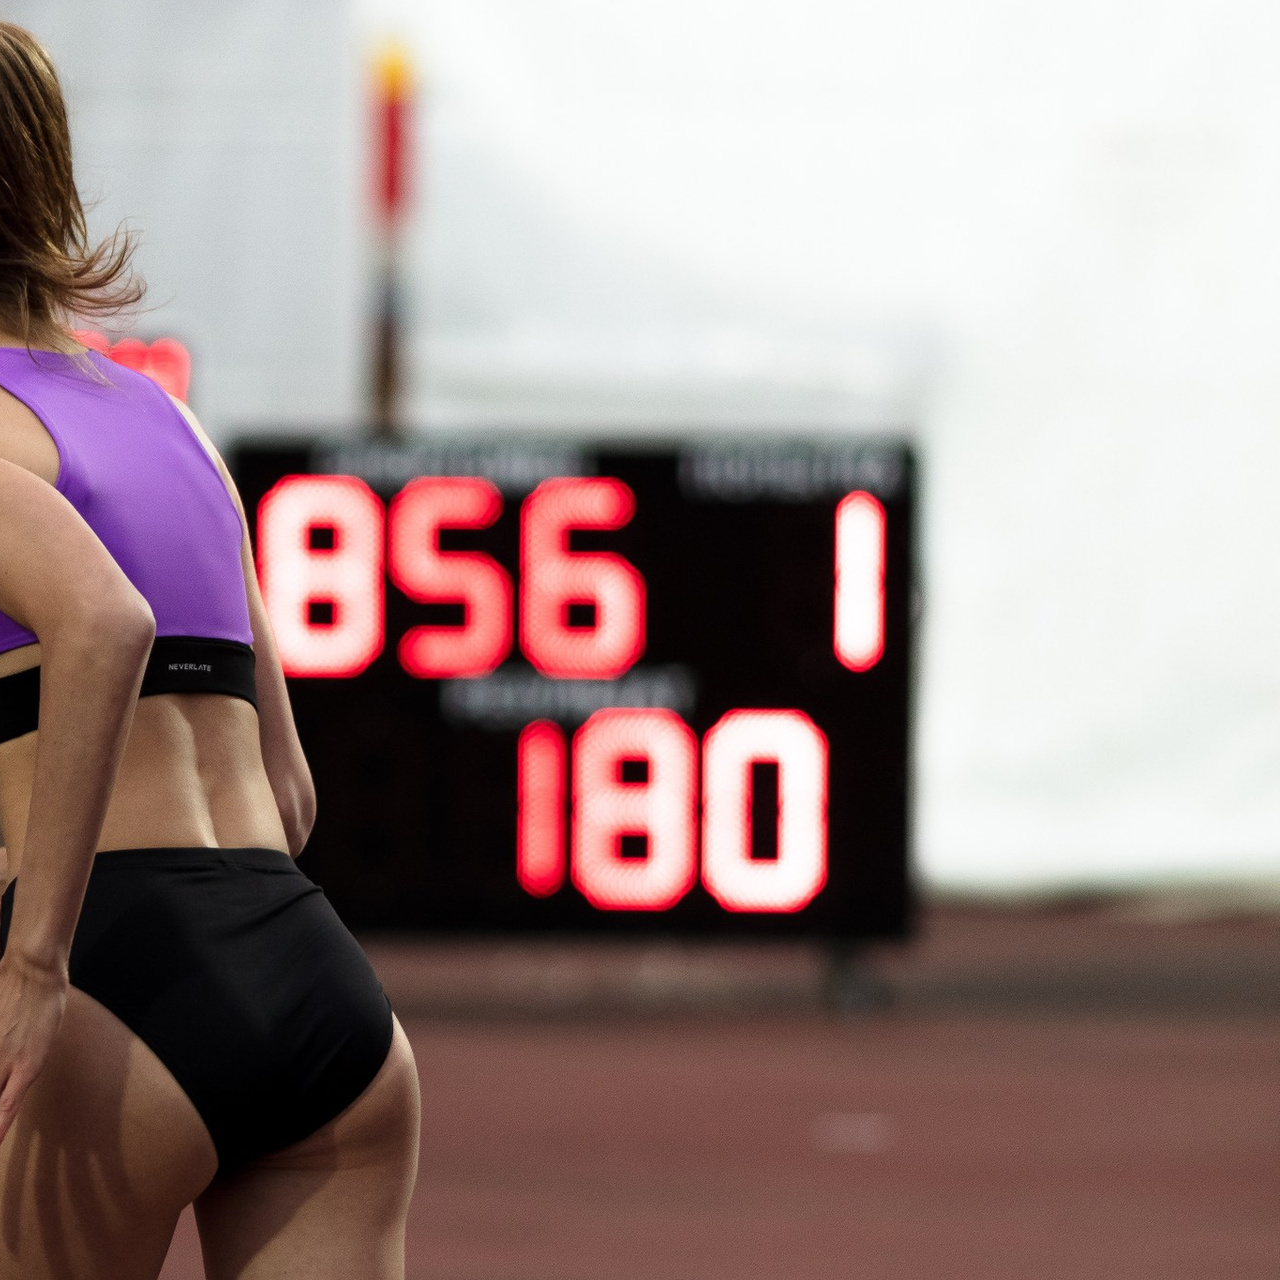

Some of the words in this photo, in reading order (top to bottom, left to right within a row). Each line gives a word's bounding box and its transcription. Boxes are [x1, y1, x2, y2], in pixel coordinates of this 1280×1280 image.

[168, 663, 212, 672] NEVERLATE
[257, 475, 646, 679] 856
[835, 490, 887, 672] 1
[518, 708, 829, 913] 180
